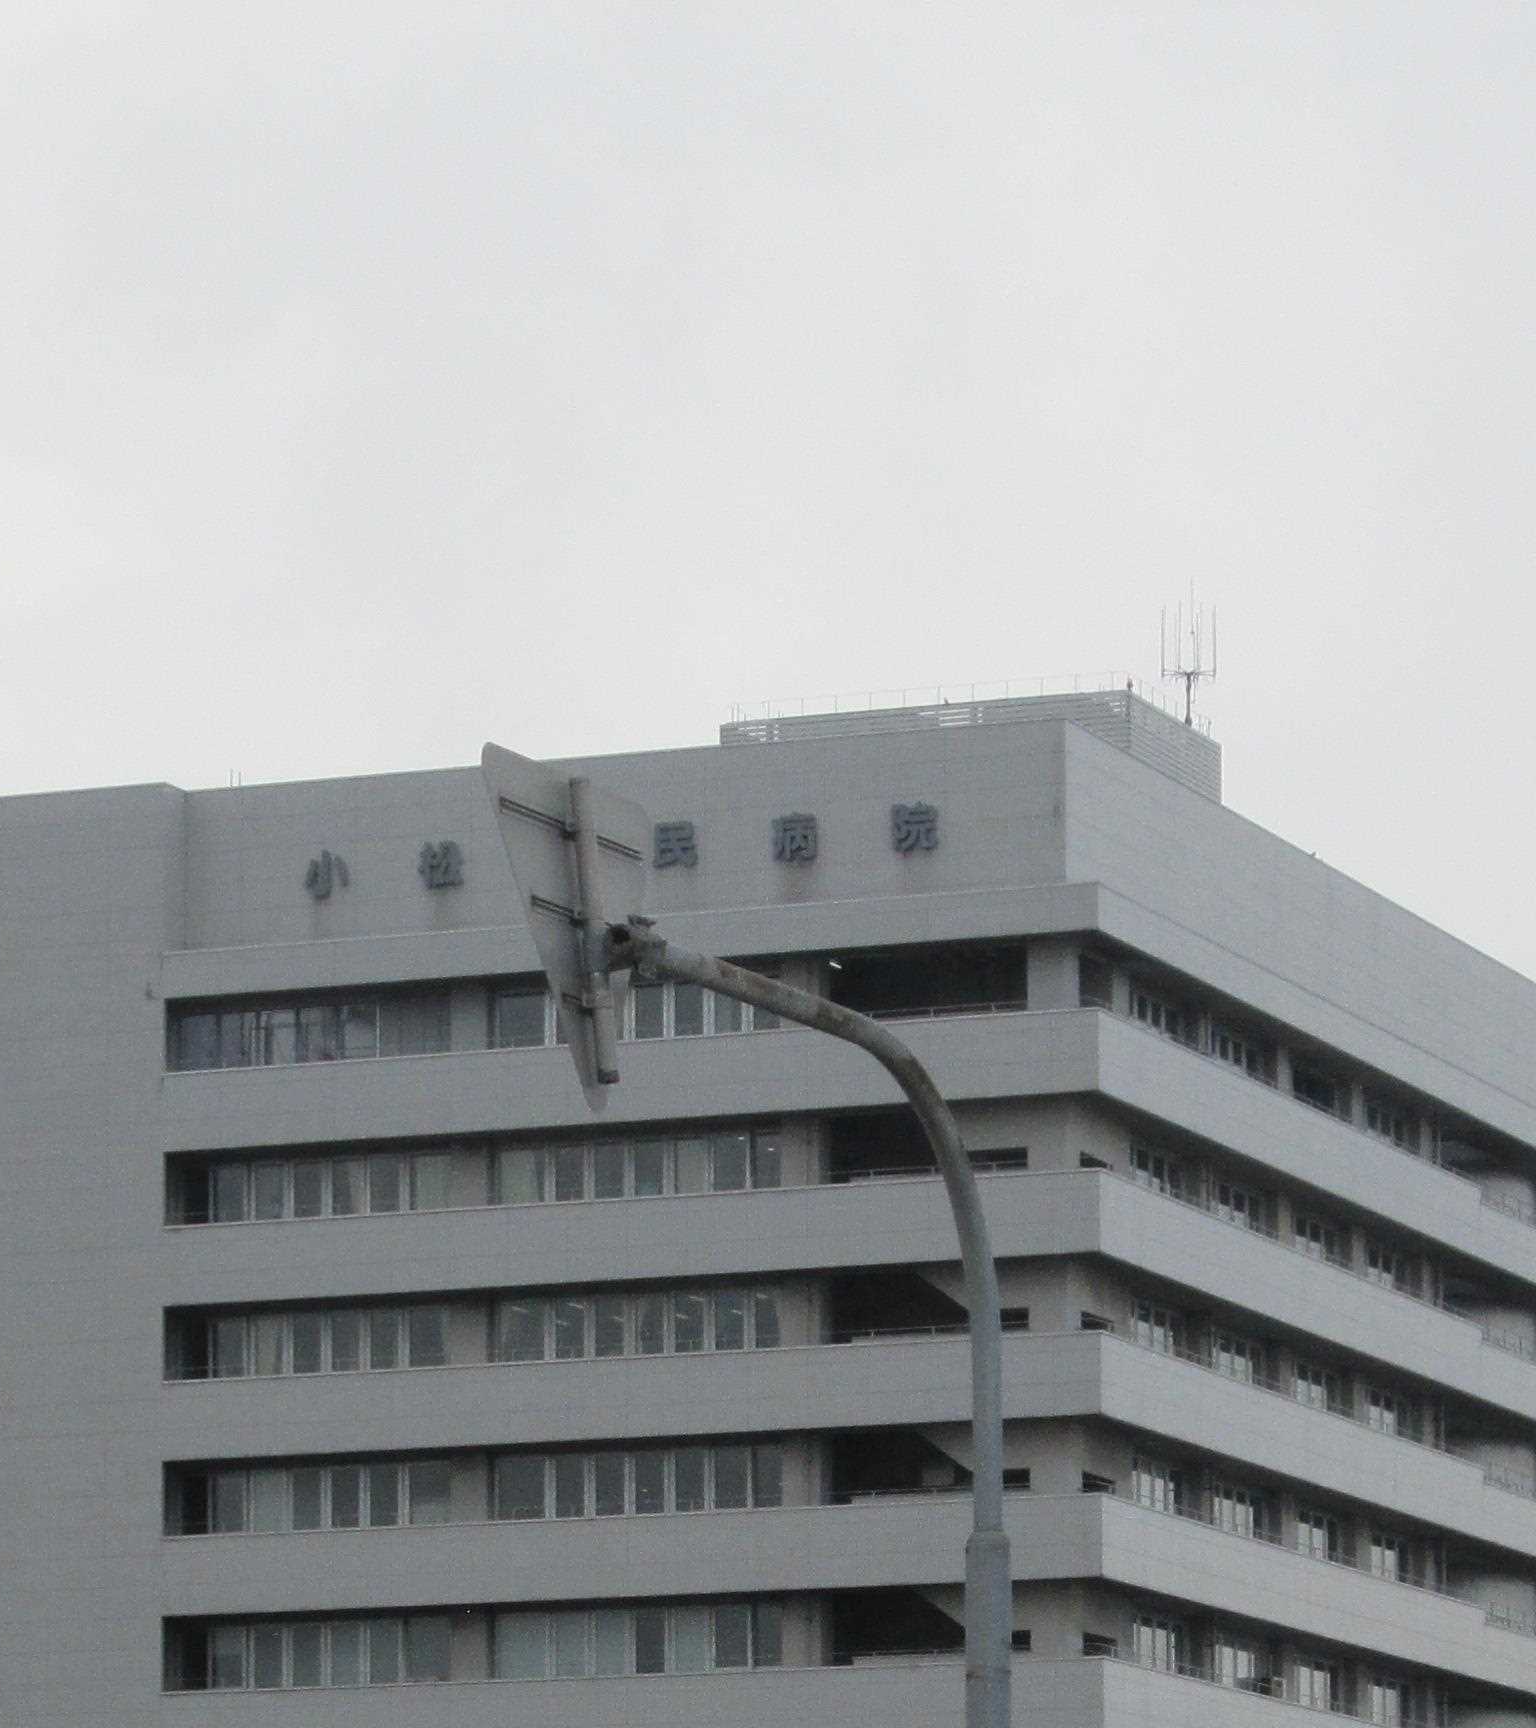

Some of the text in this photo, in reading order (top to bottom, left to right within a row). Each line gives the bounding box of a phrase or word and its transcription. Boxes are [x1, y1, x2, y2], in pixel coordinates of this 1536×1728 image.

[304, 800, 939, 900] 小松民病院
